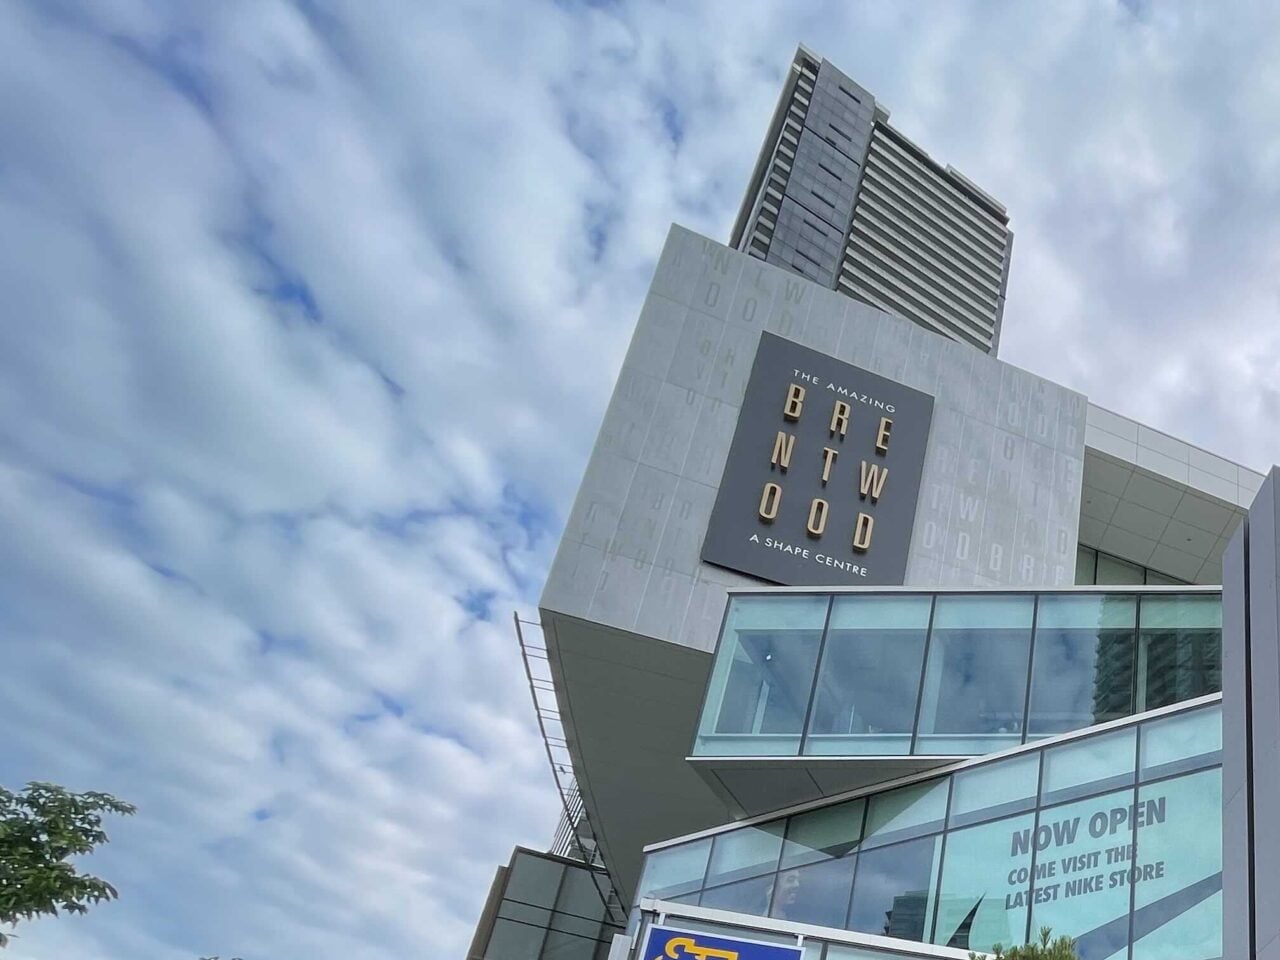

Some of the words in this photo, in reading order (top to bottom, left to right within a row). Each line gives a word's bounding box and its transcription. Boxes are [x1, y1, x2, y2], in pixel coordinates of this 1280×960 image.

[793, 369, 820, 385] THE
[827, 382, 897, 413] AMAZING
[749, 534, 760, 544] A
[765, 538, 810, 560] SHAPE
[815, 554, 869, 578] CENTRE
[1010, 817, 1081, 857] NOW
[1088, 797, 1166, 838] OPEN
[1005, 884, 1061, 910] LATEST
[1064, 875, 1104, 898] NIKE
[1109, 861, 1165, 889] STORE
[1007, 861, 1056, 886] COME
[1061, 851, 1102, 875] VISIT
[1105, 842, 1138, 865] THE
